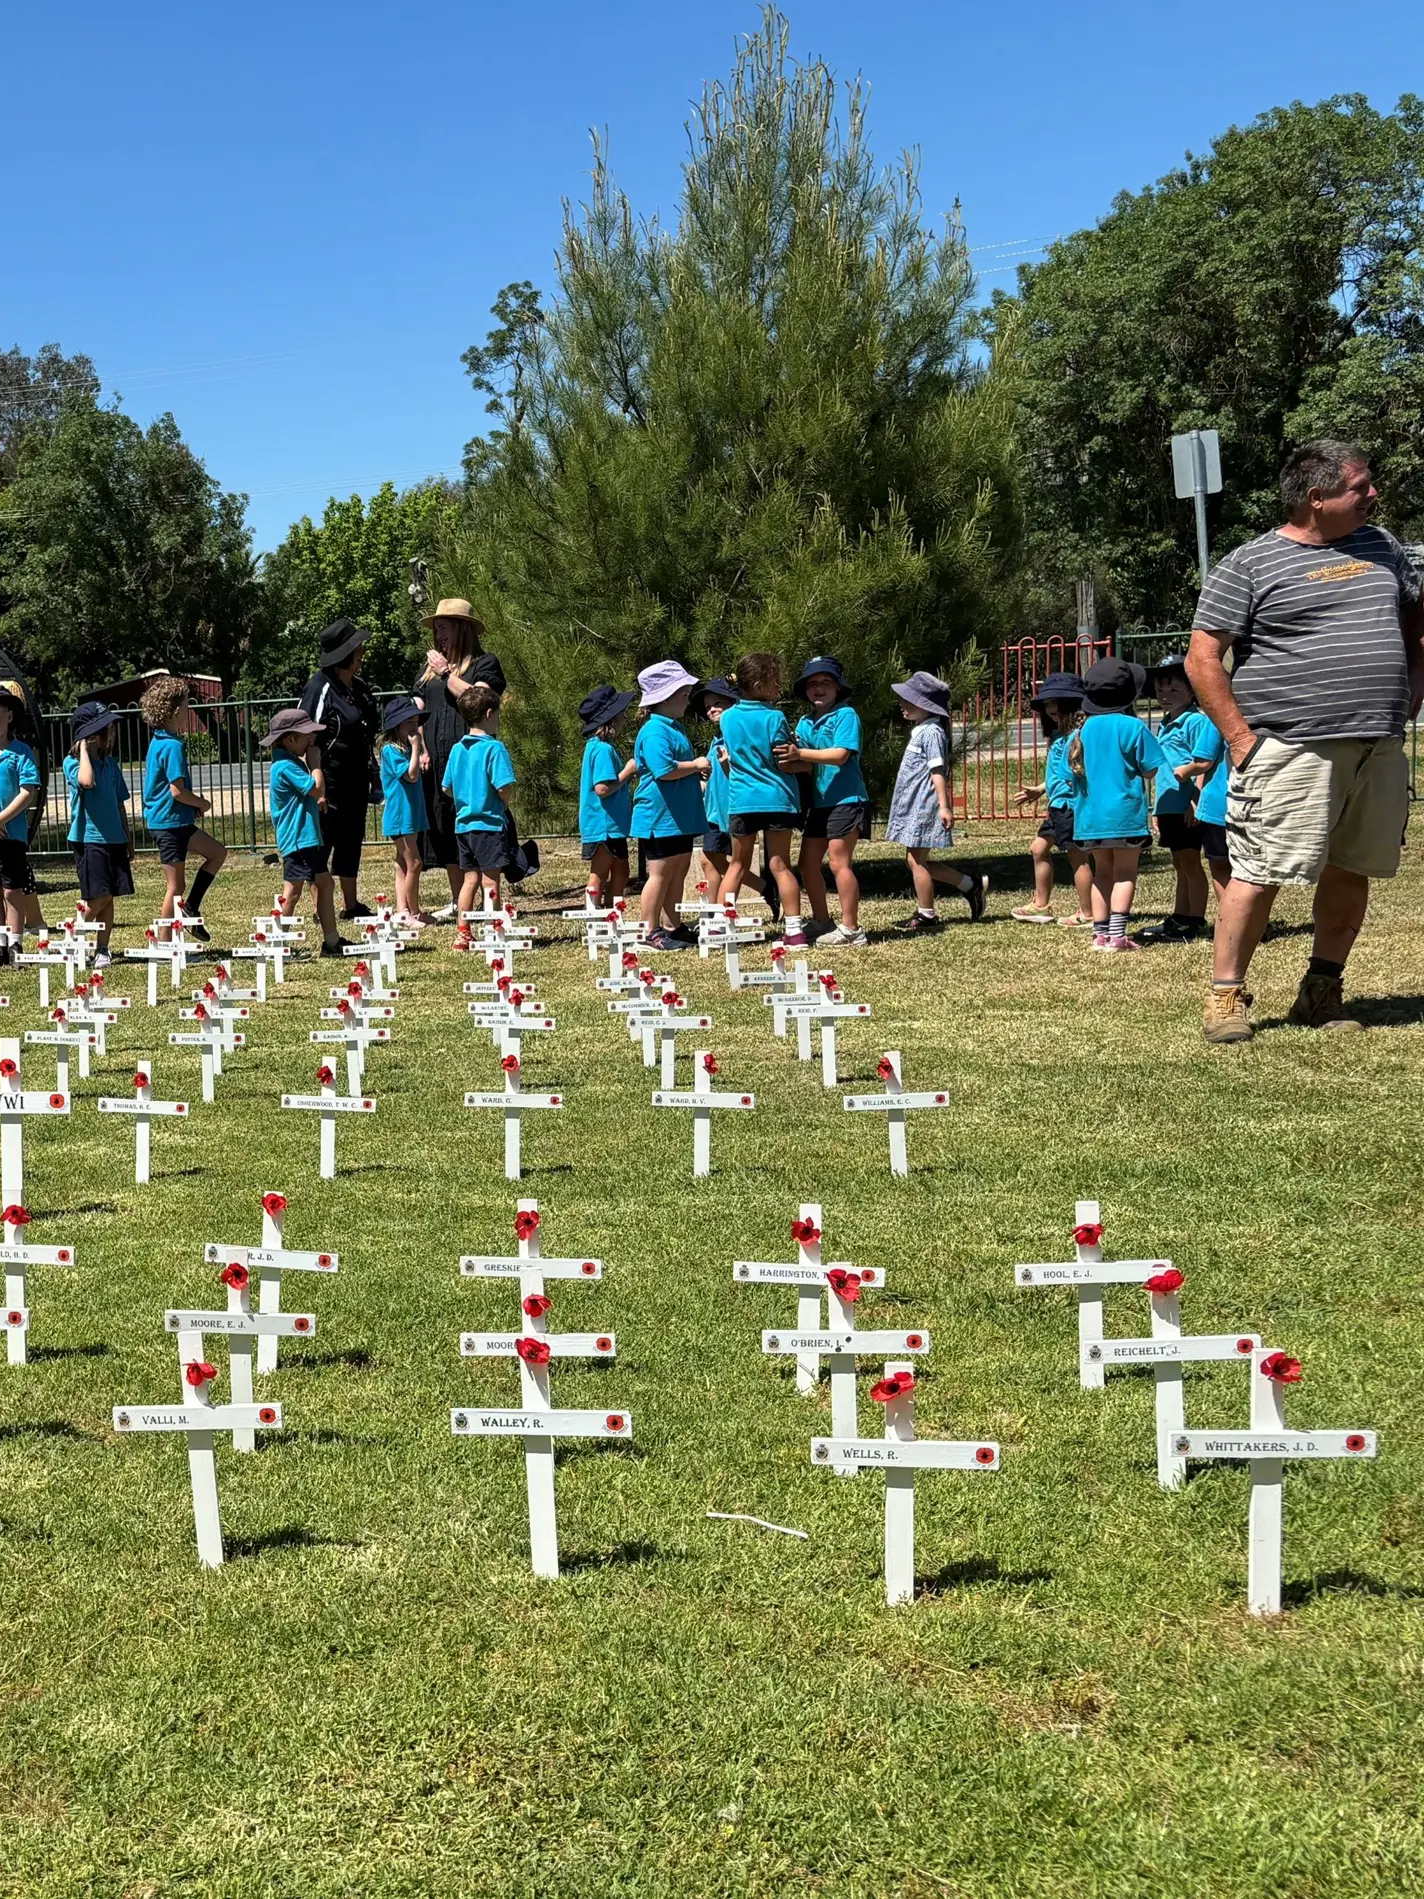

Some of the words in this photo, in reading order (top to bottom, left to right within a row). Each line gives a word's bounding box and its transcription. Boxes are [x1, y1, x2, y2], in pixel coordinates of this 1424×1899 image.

[759, 1269, 819, 1280] HARRINGTON,
[1044, 1271, 1070, 1279] HOOL,
[190, 1320, 224, 1329] MOORE,
[227, 1320, 236, 1328] E.
[487, 1341, 516, 1349] MOOR
[791, 1339, 833, 1349] O'BRIEN,
[1114, 1346, 1170, 1357] REICHELT,
[1172, 1346, 1181, 1354] J.
[142, 1415, 176, 1425] VALLI,
[179, 1415, 189, 1424] M.
[481, 1417, 531, 1429] WALLEY,
[533, 1419, 543, 1428] R.
[1204, 1441, 1289, 1453] WHITTAKERS,
[1293, 1442, 1303, 1452] J.
[1307, 1442, 1319, 1452] D.
[843, 1448, 884, 1460] WELLS,
[888, 1450, 898, 1459] R.
